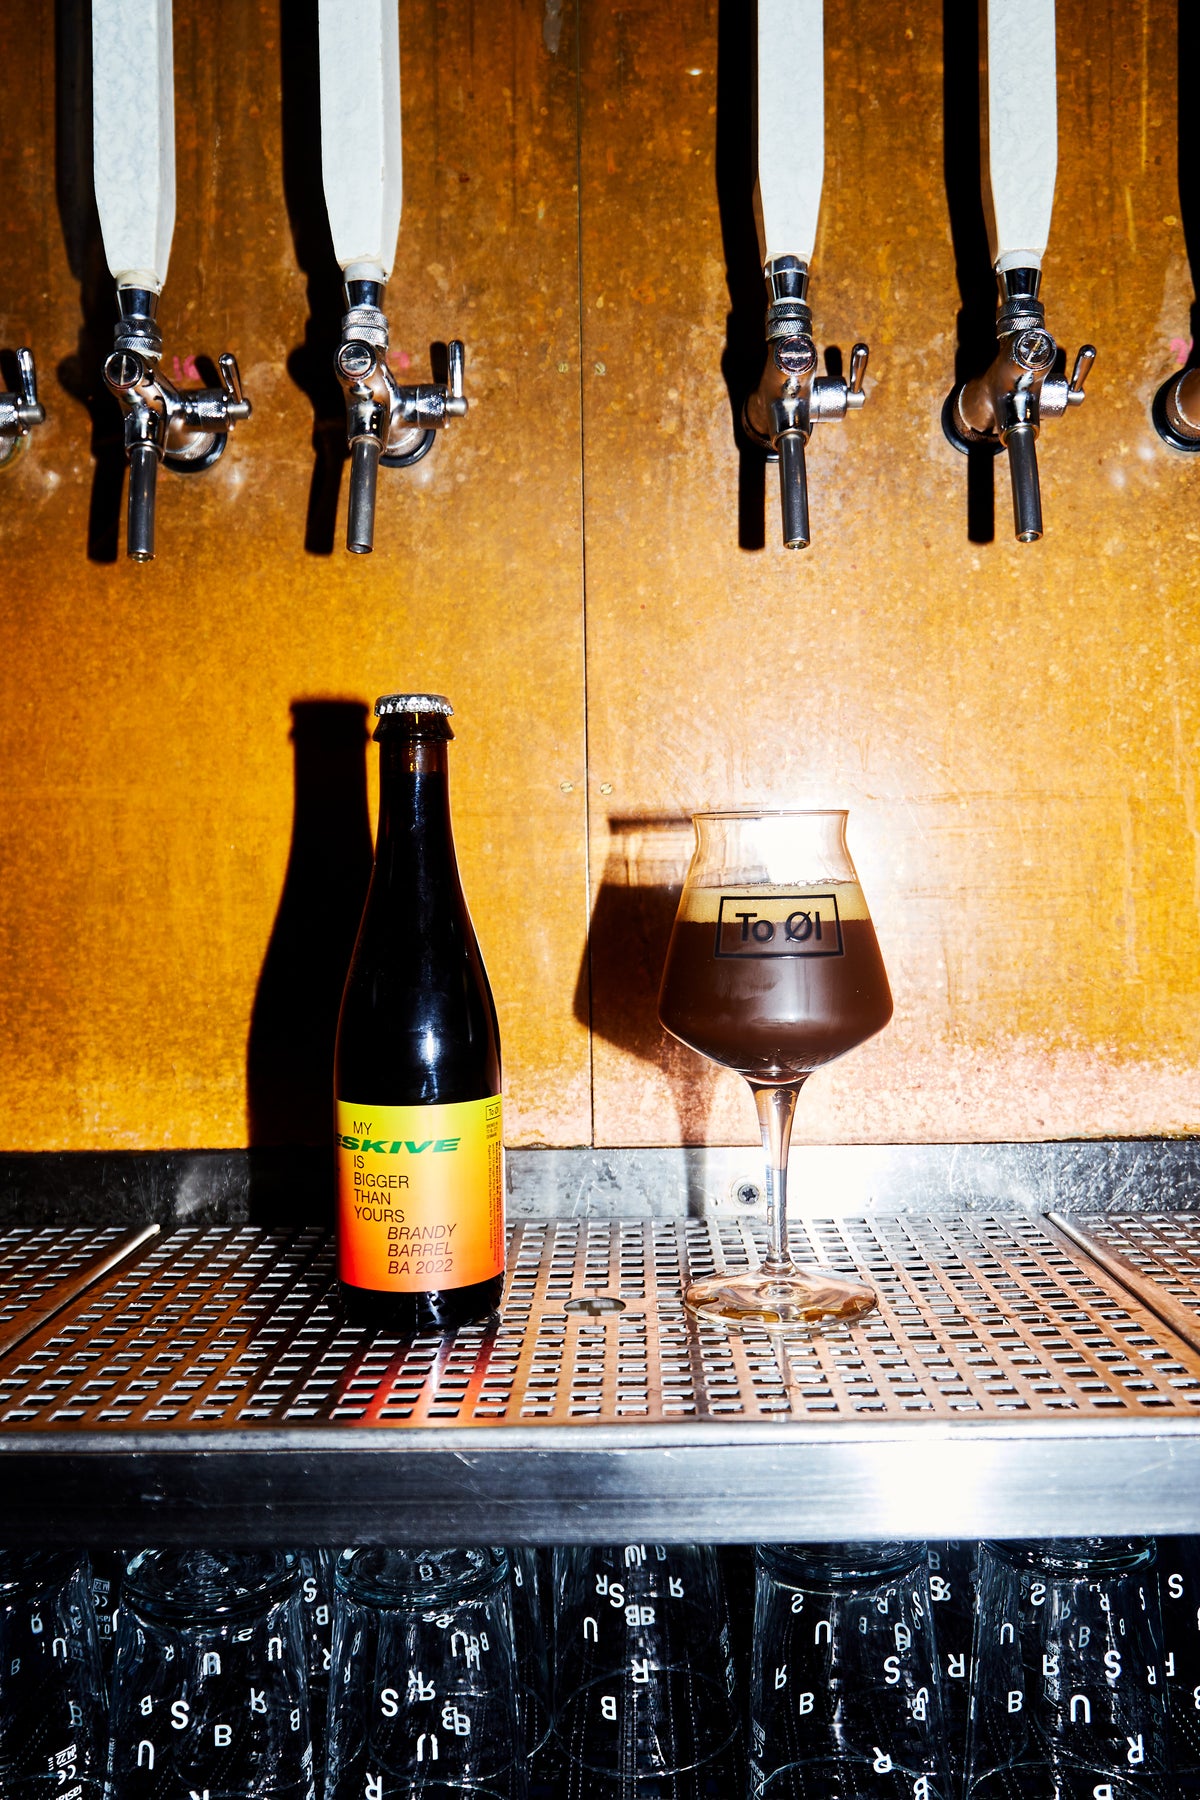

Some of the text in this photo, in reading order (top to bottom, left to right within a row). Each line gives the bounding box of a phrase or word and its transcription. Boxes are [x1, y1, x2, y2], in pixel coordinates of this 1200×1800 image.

[735, 912, 774, 942] To
[353, 1120, 373, 1136] MY
[353, 1154, 365, 1169] IS
[353, 1171, 410, 1189] BIGGER
[353, 1188, 391, 1206] THAN
[354, 1205, 405, 1223] YOURS
[387, 1223, 457, 1241] BRANDY
[387, 1241, 453, 1258] BARREL
[388, 1258, 453, 1275] BA 2022
[609, 1583, 625, 1608] S
[1168, 1574, 1184, 1599] S
[1078, 1626, 1091, 1648] B
[883, 1656, 901, 1684] S
[1104, 1650, 1122, 1679] S
[380, 1688, 399, 1717] S
[799, 1692, 815, 1715] B
[1008, 1690, 1024, 1713] B
[170, 1700, 190, 1729] S
[214, 1724, 232, 1747] B
